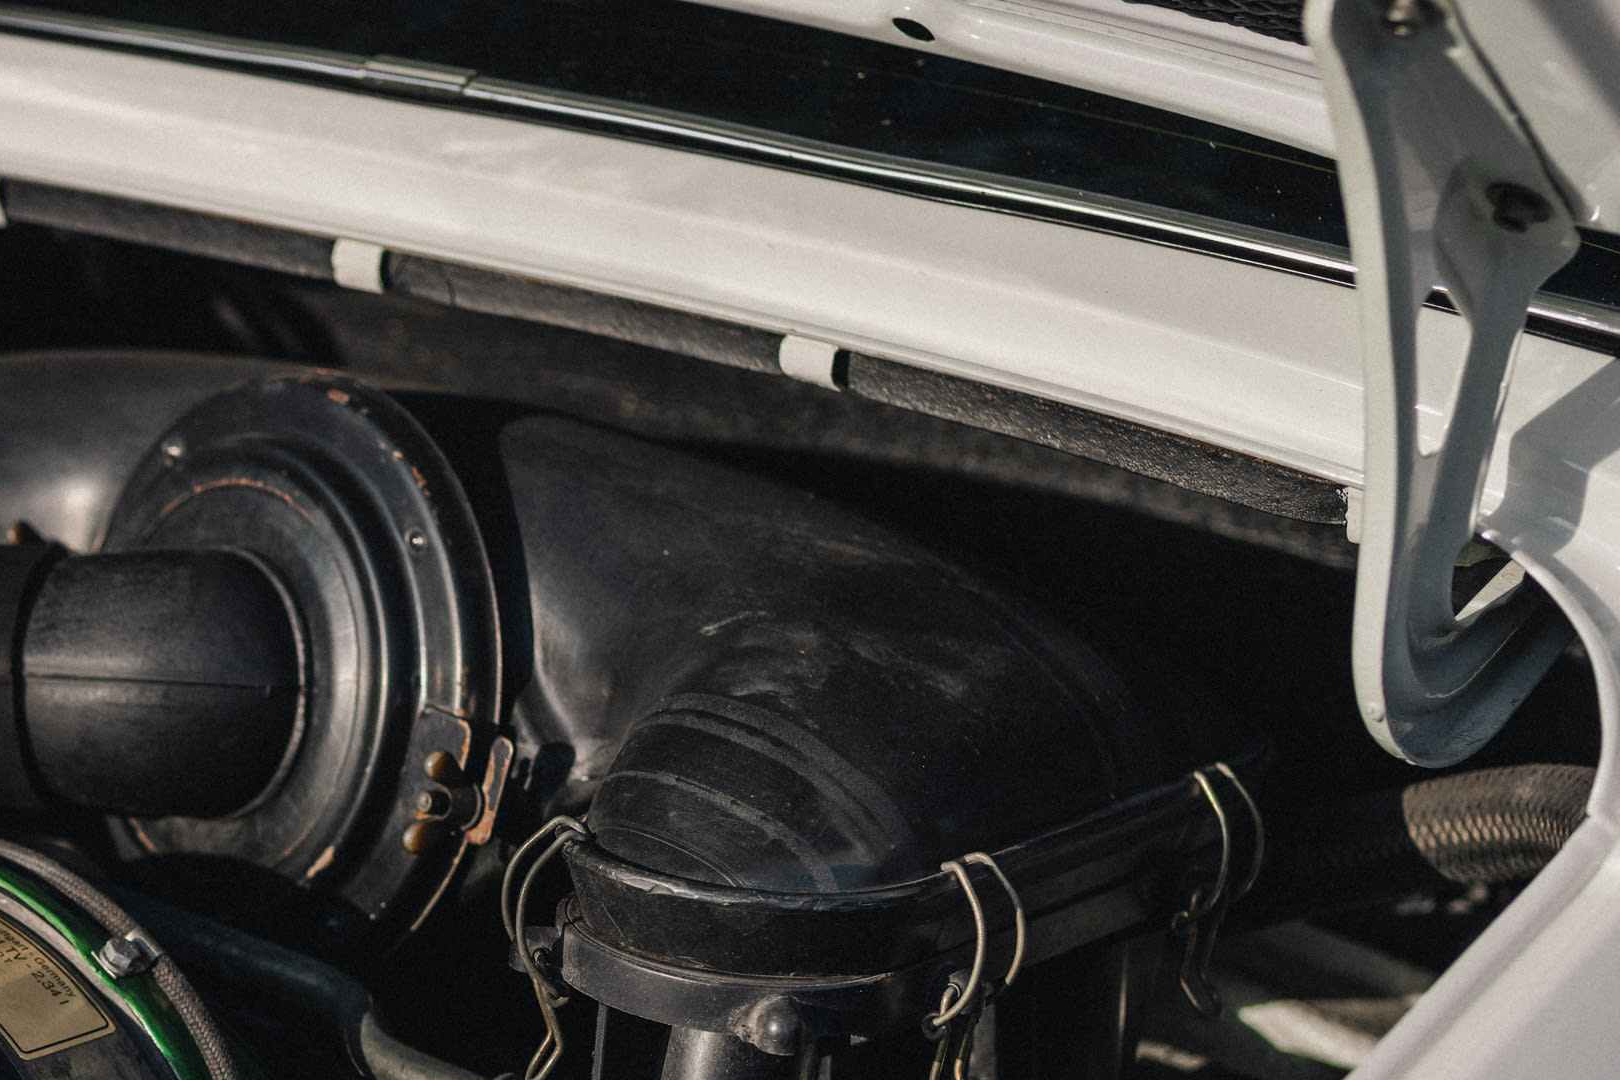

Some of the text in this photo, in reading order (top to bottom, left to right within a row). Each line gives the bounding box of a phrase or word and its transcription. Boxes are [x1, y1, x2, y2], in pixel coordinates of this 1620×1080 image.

[6, 946, 28, 961] TV
[31, 970, 62, 998] 2,34
[34, 956, 77, 998] Germany
